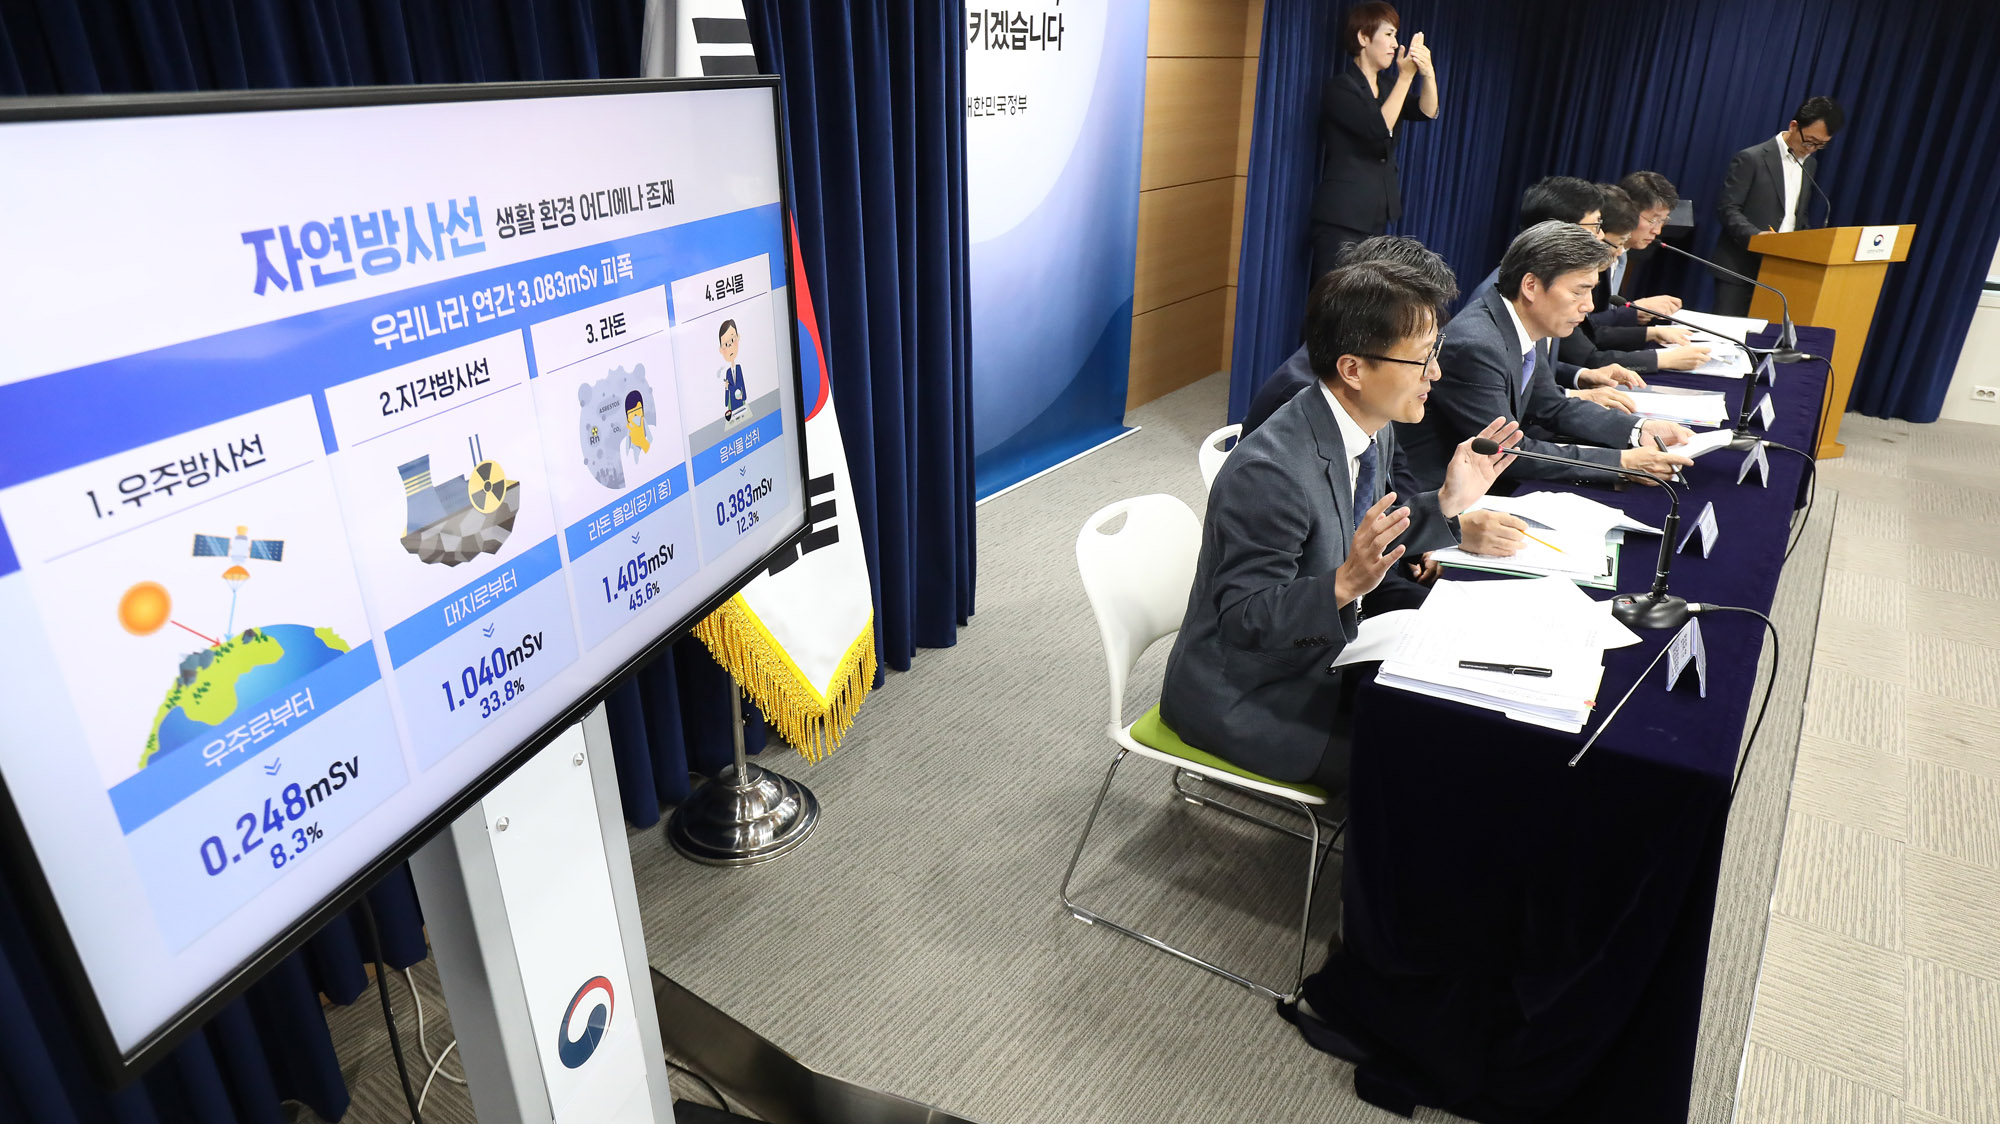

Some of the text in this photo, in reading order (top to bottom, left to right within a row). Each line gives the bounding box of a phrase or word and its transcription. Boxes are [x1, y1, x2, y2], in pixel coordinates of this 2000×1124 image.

[965, 8, 1064, 51] 키겠습니다
[495, 179, 675, 239] 생활 환경 어디에나 존재
[241, 195, 487, 296] 자연방사선
[371, 252, 634, 350] 우리나라 연간 3.083mSv 피폭
[705, 273, 744, 301] 4. 음식물
[585, 312, 626, 343] 3. 라돈
[599, 400, 620, 414] ASBESTOS
[589, 435, 600, 445] Rn
[719, 427, 760, 464] 음식물 섭취
[86, 433, 266, 519] 1. 우주방사선
[587, 478, 672, 542] 라돈 흡입(공기 중)
[716, 478, 772, 526] 0.383mSv
[736, 510, 760, 535] 12.3%
[602, 543, 674, 603] 1.405mSv
[629, 581, 660, 611] 45.6%
[443, 568, 518, 627] 대지로부터
[442, 631, 543, 712] 1.040mSv
[480, 677, 525, 719] 33.8%
[202, 687, 316, 768] 우주로부터
[200, 755, 360, 877] 0.248mSv
[270, 822, 324, 869] 8.3%
